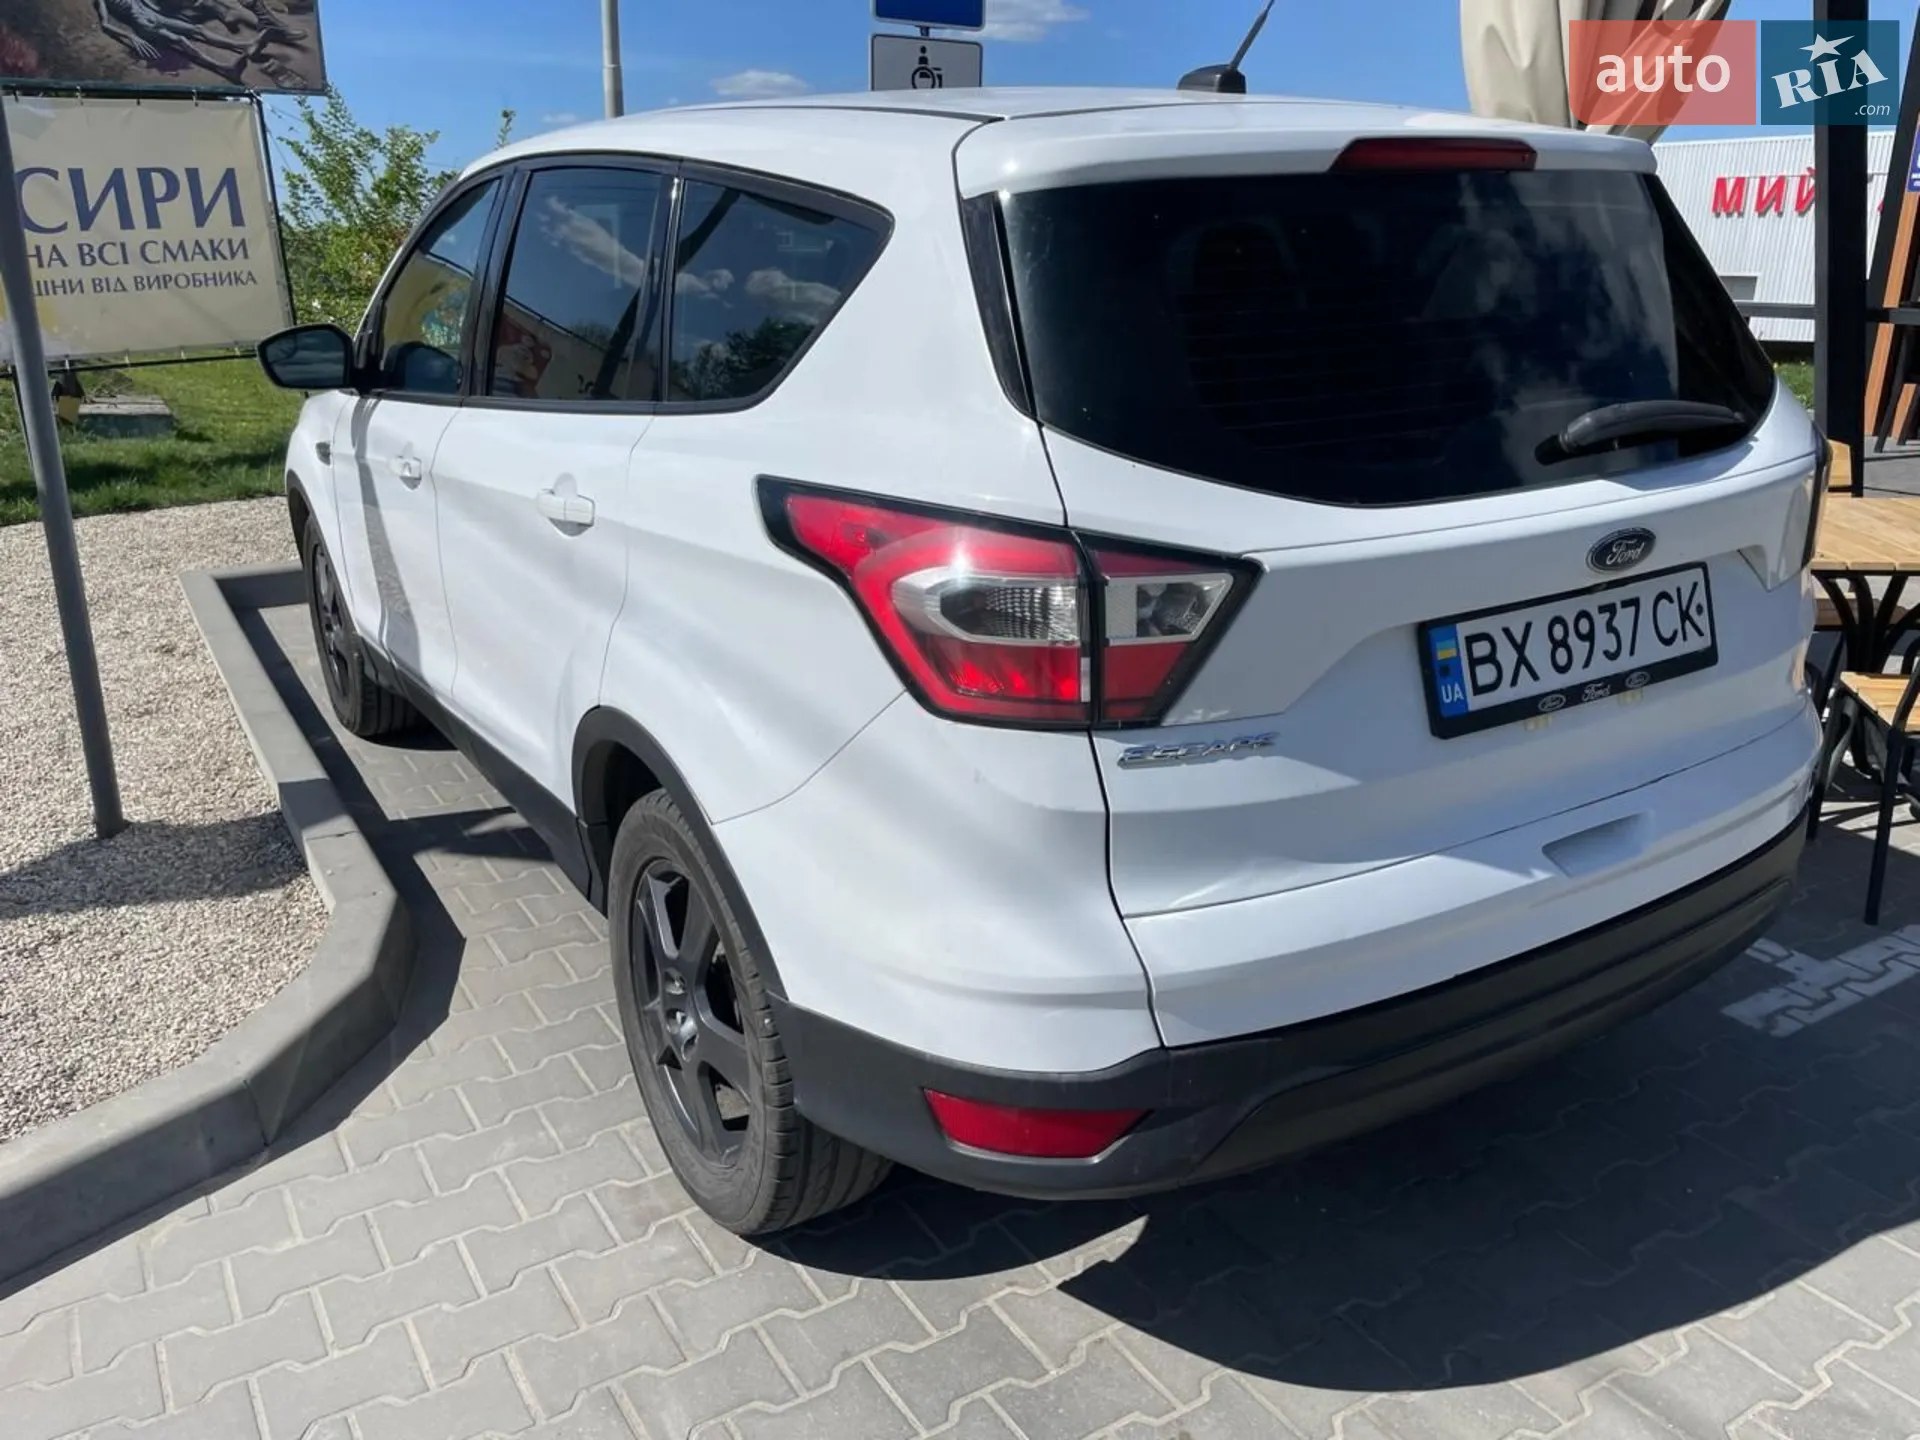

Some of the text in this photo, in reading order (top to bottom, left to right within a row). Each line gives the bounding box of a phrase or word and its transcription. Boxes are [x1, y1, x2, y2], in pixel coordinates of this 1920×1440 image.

[15, 166, 245, 235] СИРИ
[1711, 167, 1817, 213] МИЙ
[27, 237, 250, 269] НА ВСІ СМАКИ
[92, 274, 127, 294] ВІД
[132, 269, 258, 291] ВИРОБНИКА
[1605, 538, 1645, 566] Ford
[1464, 581, 1704, 697] BX 8937 CK
[1440, 684, 1465, 704] UA
[1581, 683, 1612, 702] Ford
